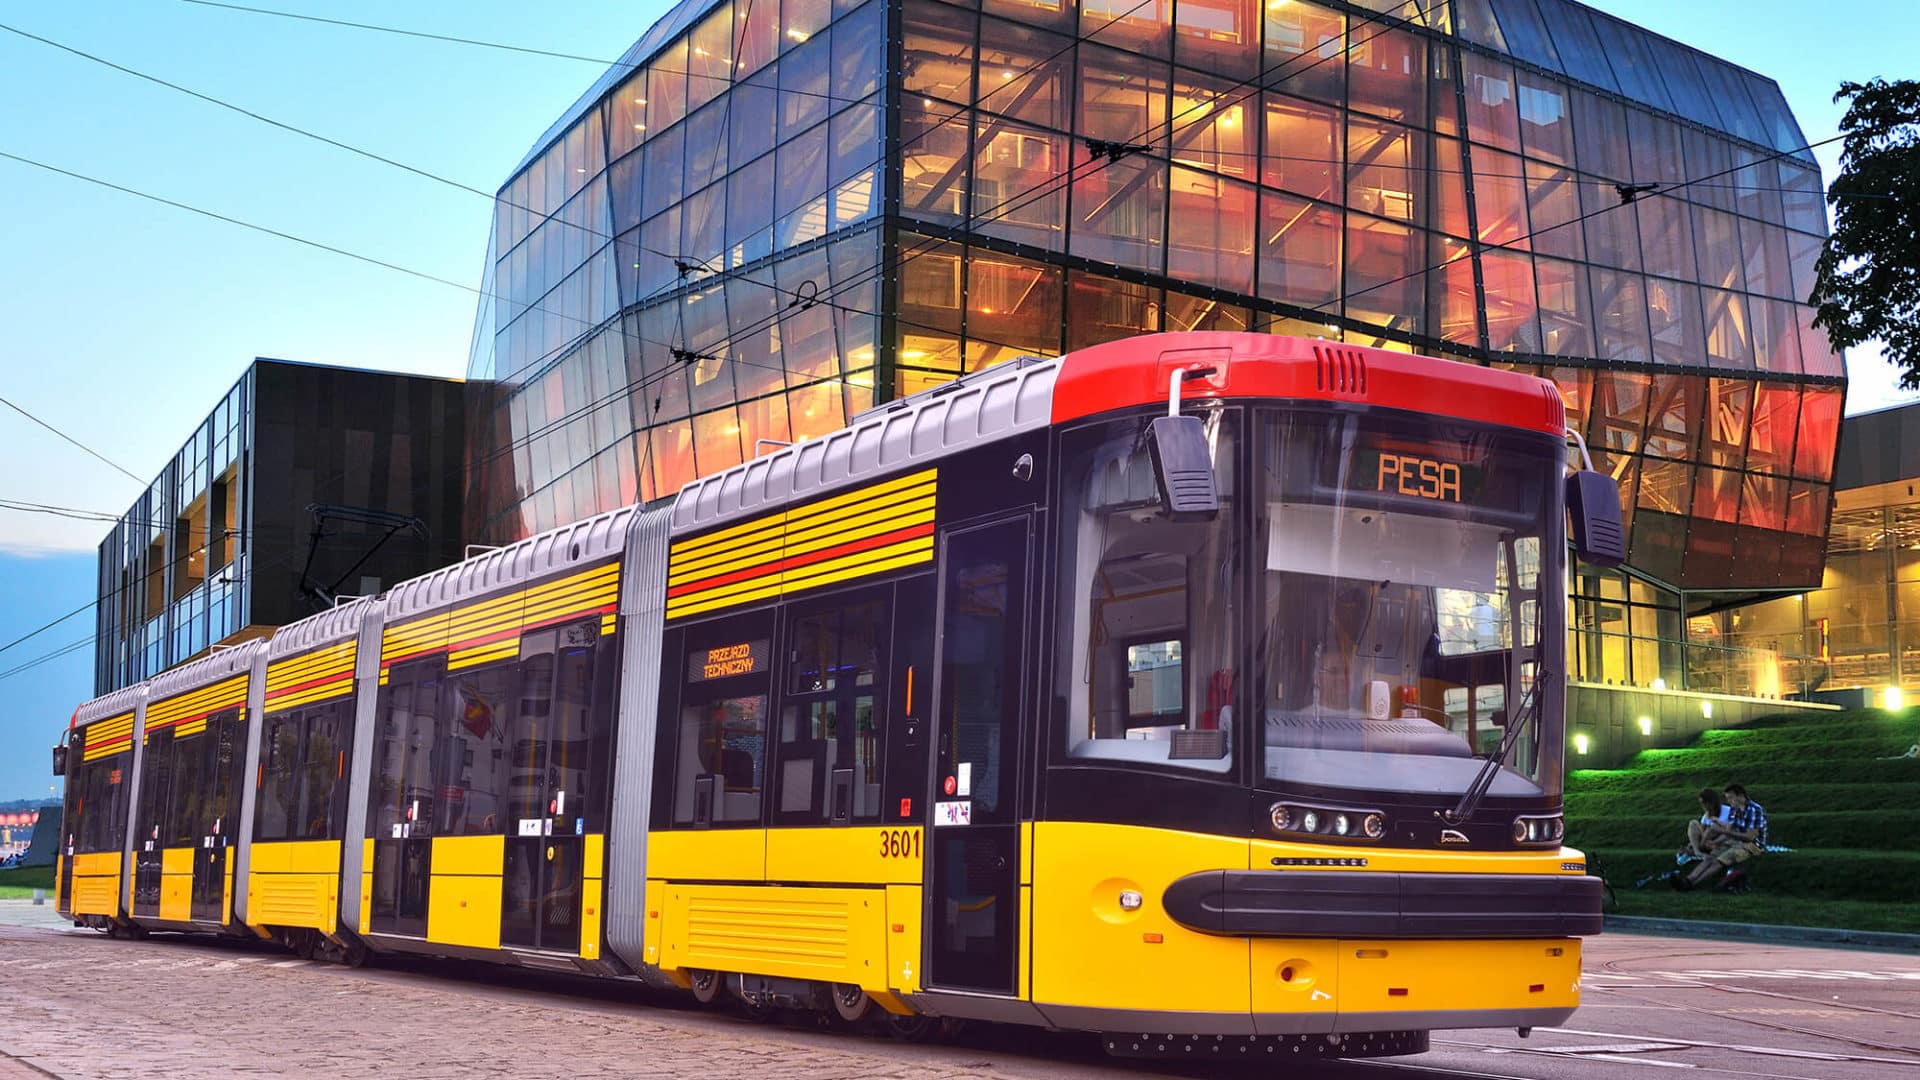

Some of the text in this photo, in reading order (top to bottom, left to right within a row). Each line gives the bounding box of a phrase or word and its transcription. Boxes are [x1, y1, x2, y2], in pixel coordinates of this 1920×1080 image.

[1378, 453, 1460, 502] PESA
[708, 643, 750, 663] PRZEJAZD
[703, 657, 754, 679] TECHNICZNY
[880, 829, 920, 859] 3601
